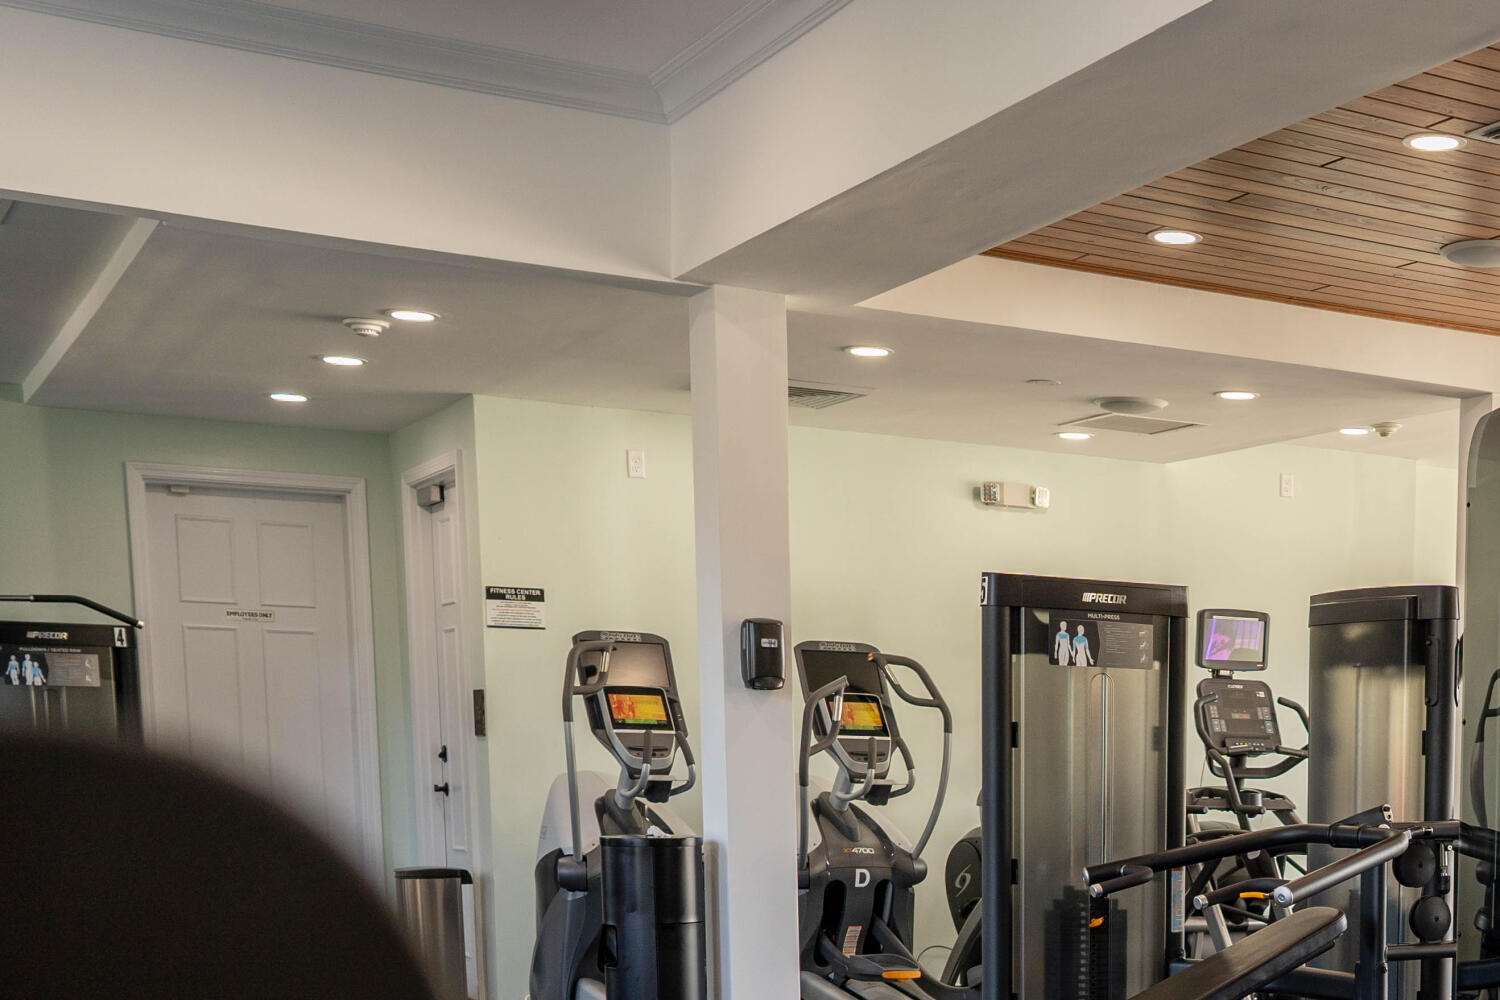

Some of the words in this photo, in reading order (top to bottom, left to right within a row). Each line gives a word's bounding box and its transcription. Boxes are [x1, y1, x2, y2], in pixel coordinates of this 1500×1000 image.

[489, 587, 516, 595] FITNESS
[516, 588, 542, 596] CENTER
[1090, 592, 1127, 604] PRECOR
[1087, 612, 1121, 620] MULTI-PRESS
[33, 631, 69, 640] PRECOR
[855, 868, 871, 888] D
